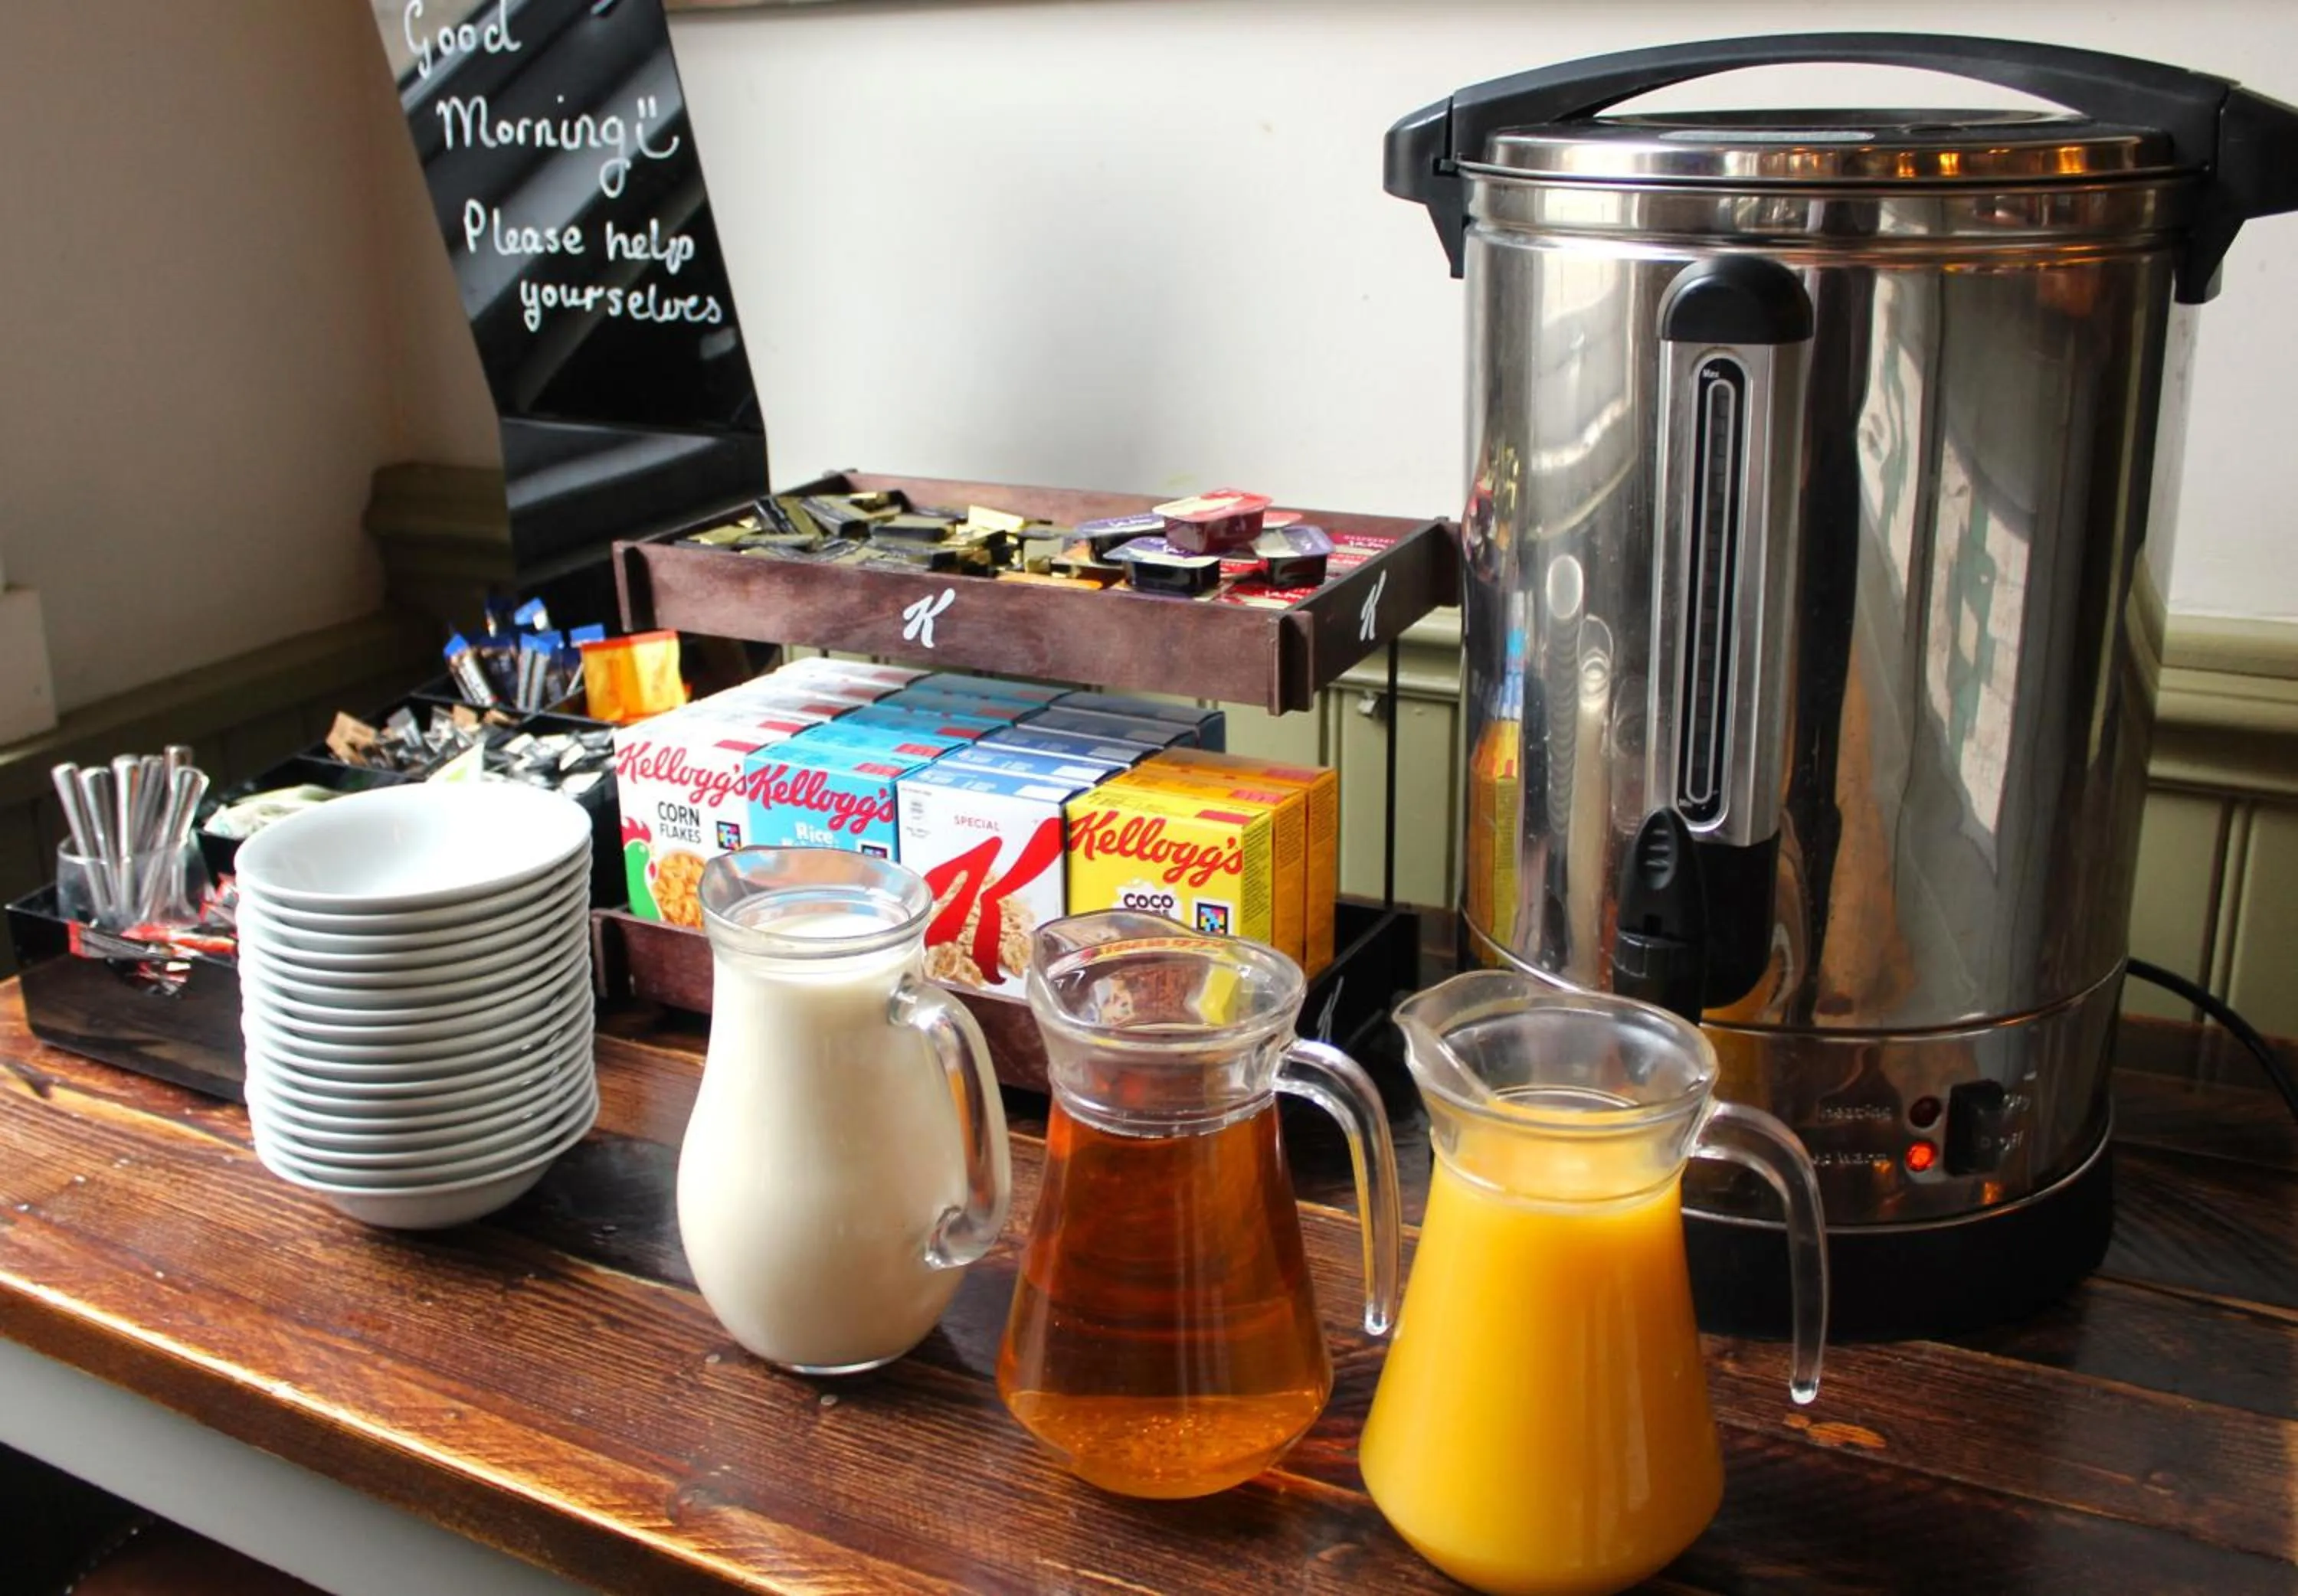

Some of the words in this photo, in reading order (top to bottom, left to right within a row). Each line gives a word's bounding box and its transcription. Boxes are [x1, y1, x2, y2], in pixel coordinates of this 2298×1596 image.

[404, 0, 522, 78] Good
[436, 95, 632, 198] Morning
[463, 199, 584, 256] Please
[605, 218, 695, 273] help
[520, 280, 723, 332] yourselves
[902, 588, 954, 649] K
[614, 741, 747, 807] Kellogg's
[746, 764, 895, 834] Kellogg's
[657, 801, 700, 828] CORN
[660, 823, 702, 844] FLAKES
[794, 821, 834, 845] Rice
[954, 814, 1000, 832] SPECIAL
[1069, 809, 1243, 888] Kellogg's
[924, 817, 1064, 985] K
[1123, 892, 1174, 910] COCO
